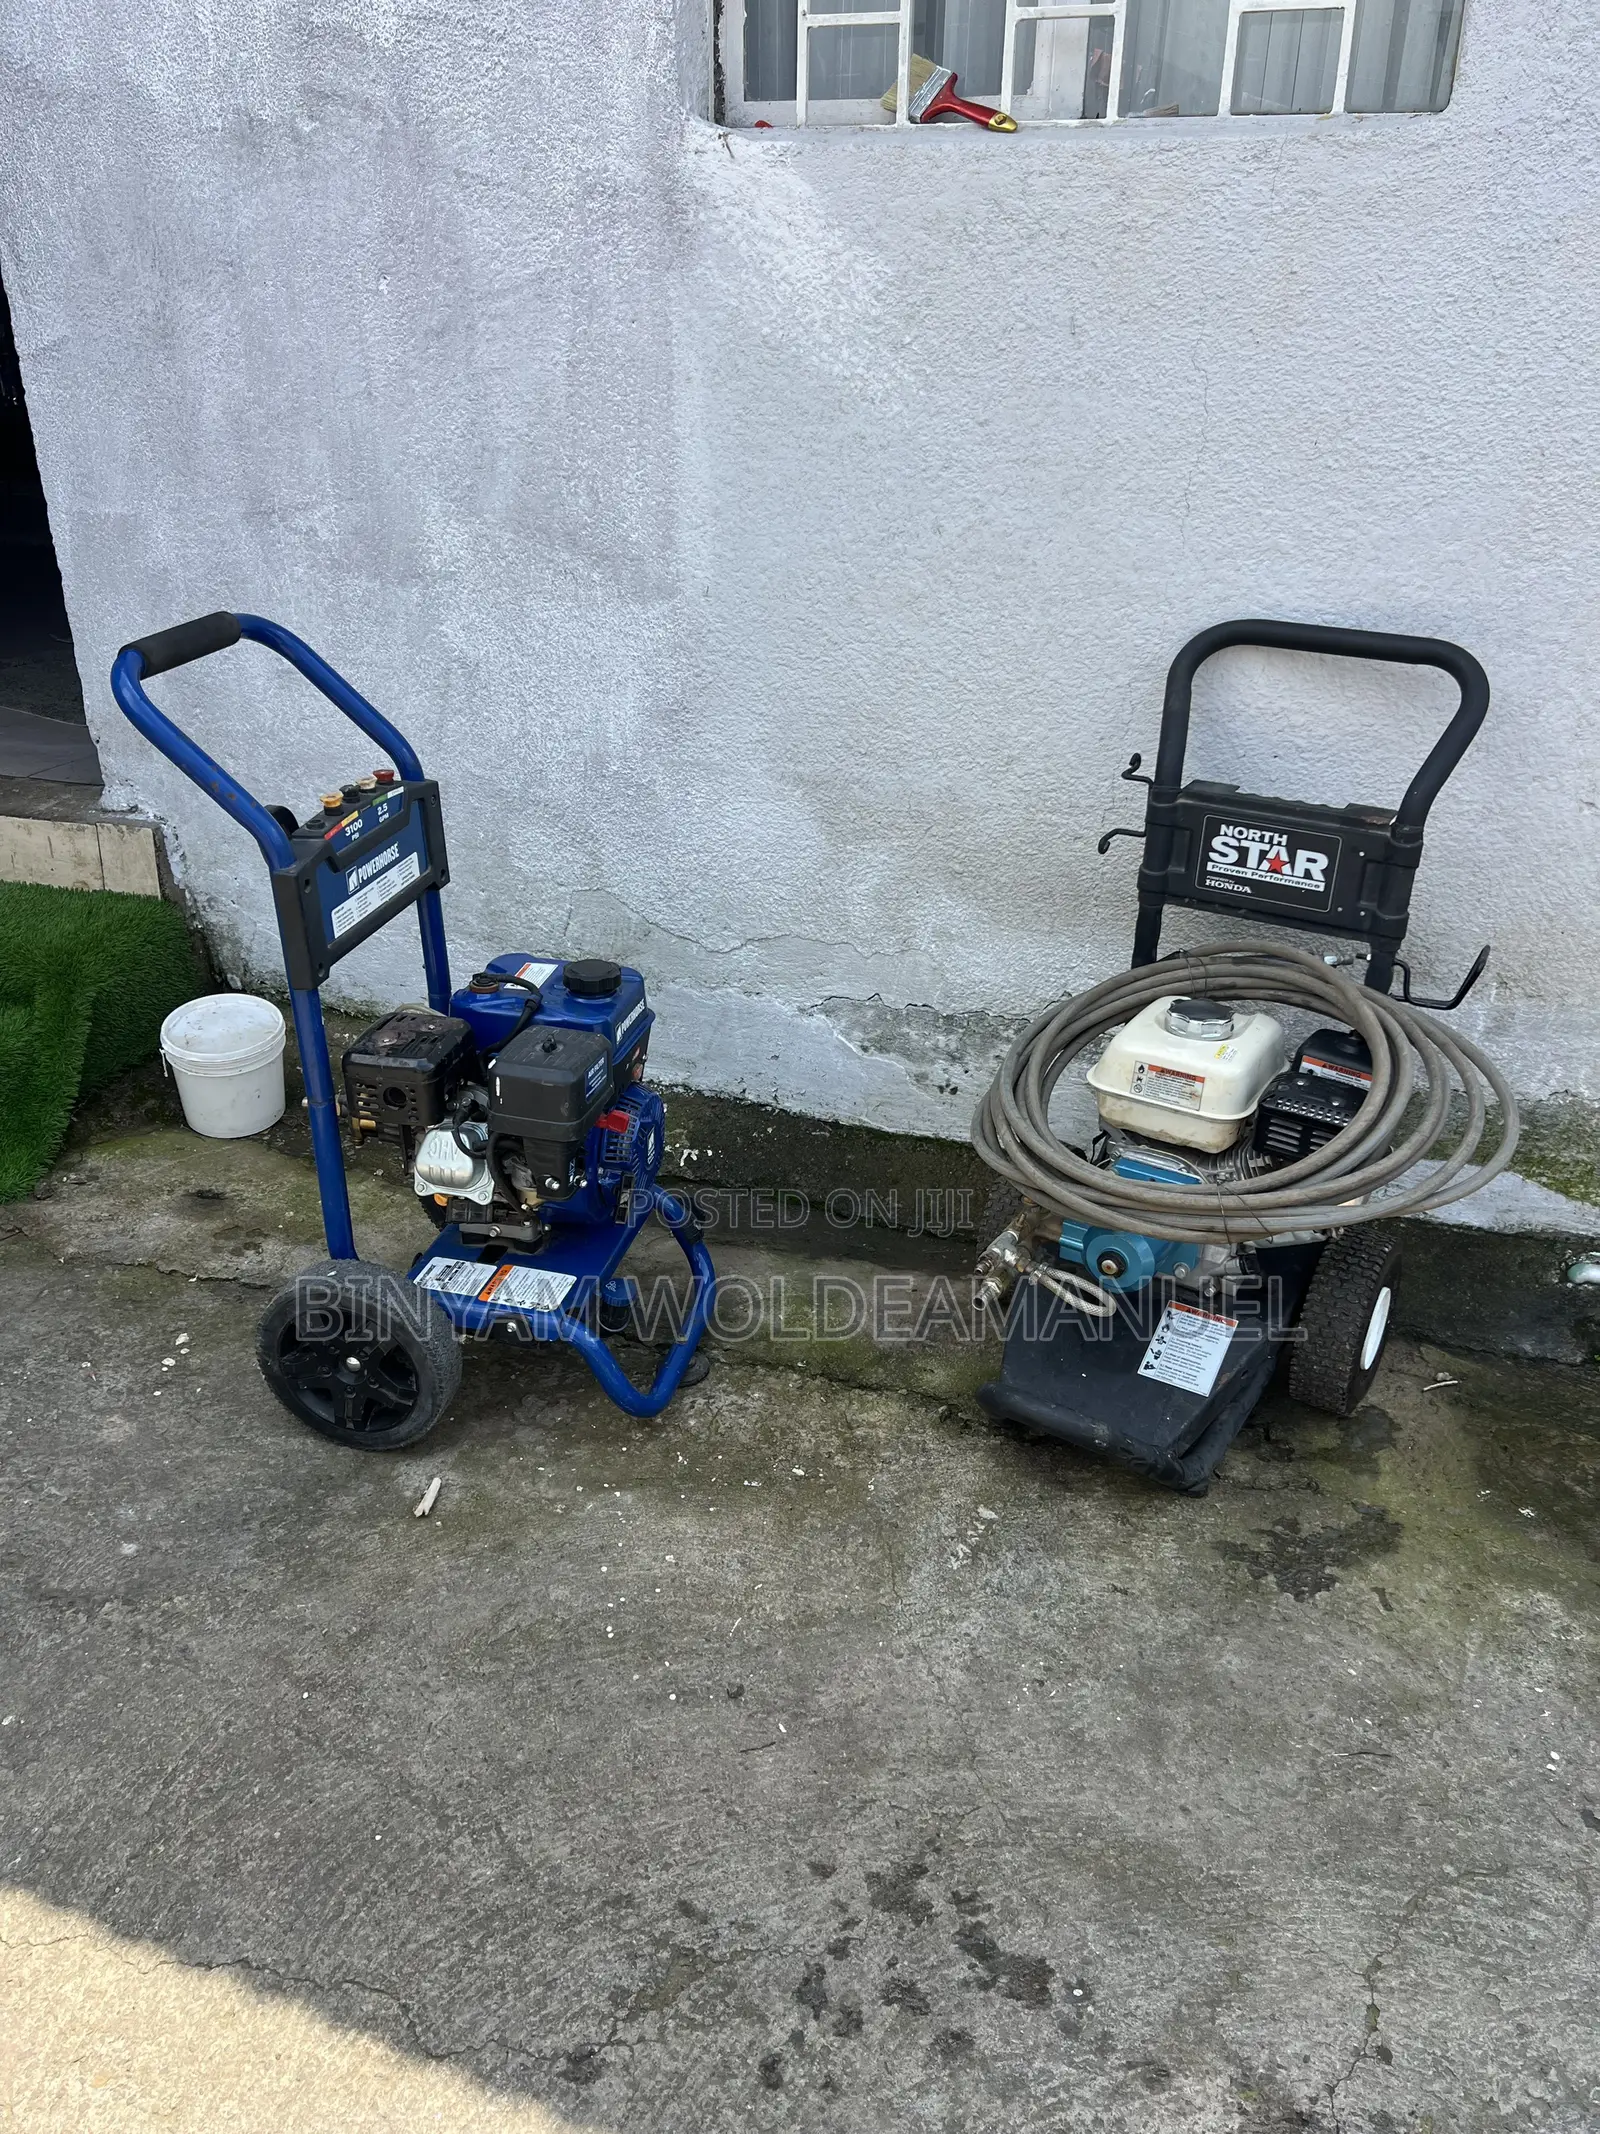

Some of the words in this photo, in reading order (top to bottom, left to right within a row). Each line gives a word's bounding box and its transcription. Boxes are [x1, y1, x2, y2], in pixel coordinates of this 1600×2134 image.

[377, 803, 388, 816] 2.5
[345, 819, 363, 836] 3100
[1220, 824, 1288, 846] NORTH
[358, 843, 400, 884] POWERHORSE
[1208, 835, 1329, 882] STAR
[1205, 879, 1252, 894] HONDA
[1211, 864, 1248, 877] Proven
[1251, 872, 1321, 890] Performance
[1165, 1069, 1197, 1081] WARNING
